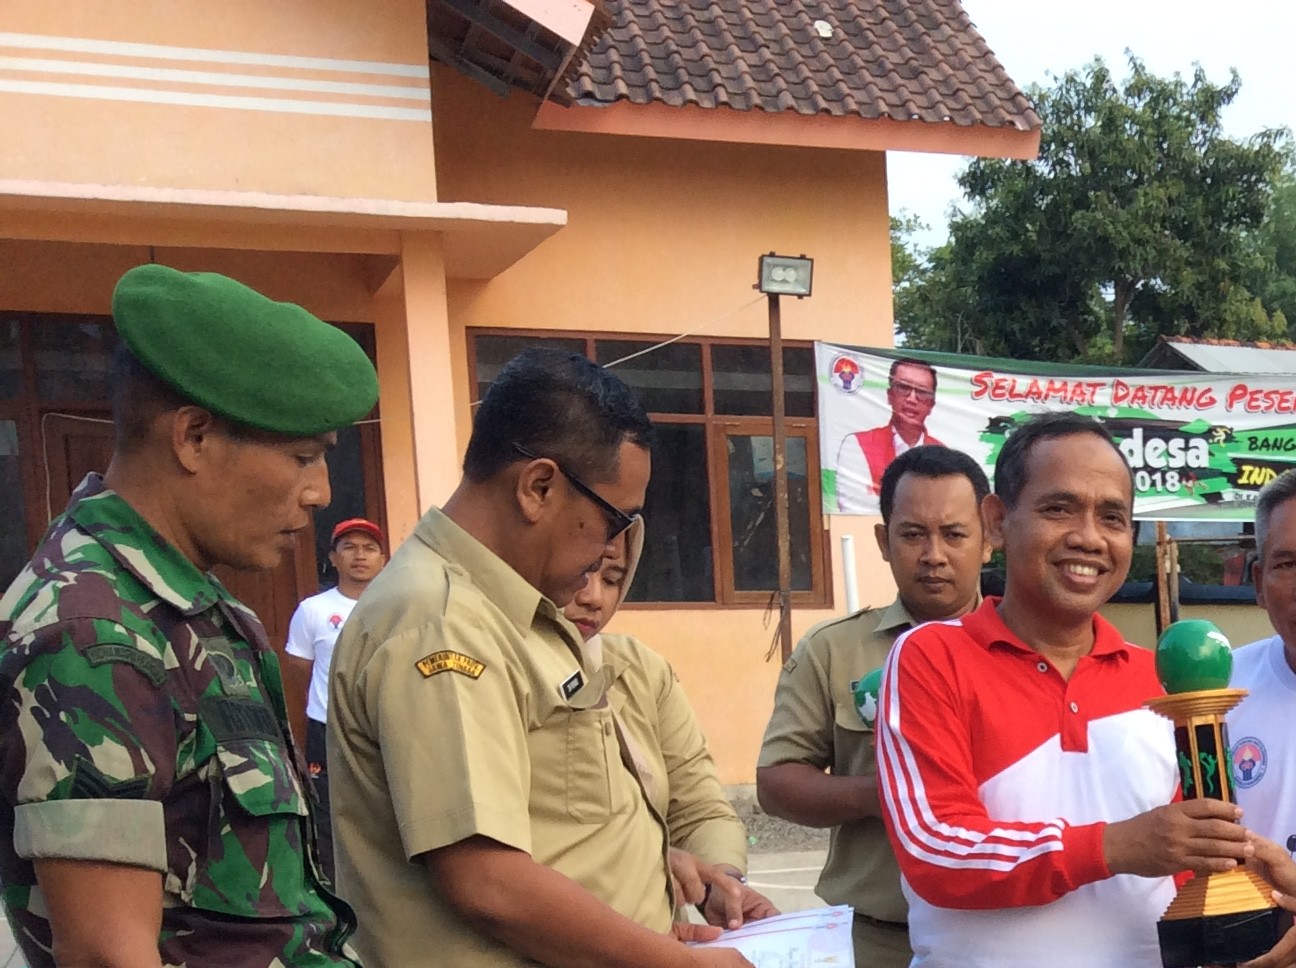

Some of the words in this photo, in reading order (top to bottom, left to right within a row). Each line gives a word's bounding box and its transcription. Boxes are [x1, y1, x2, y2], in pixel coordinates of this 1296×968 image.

[972, 371, 1106, 405] SELAMAT
[1112, 379, 1218, 411] DATANG
[1119, 428, 1209, 469] desa
[1135, 470, 1181, 492] 018
[1237, 464, 1290, 486] IND
